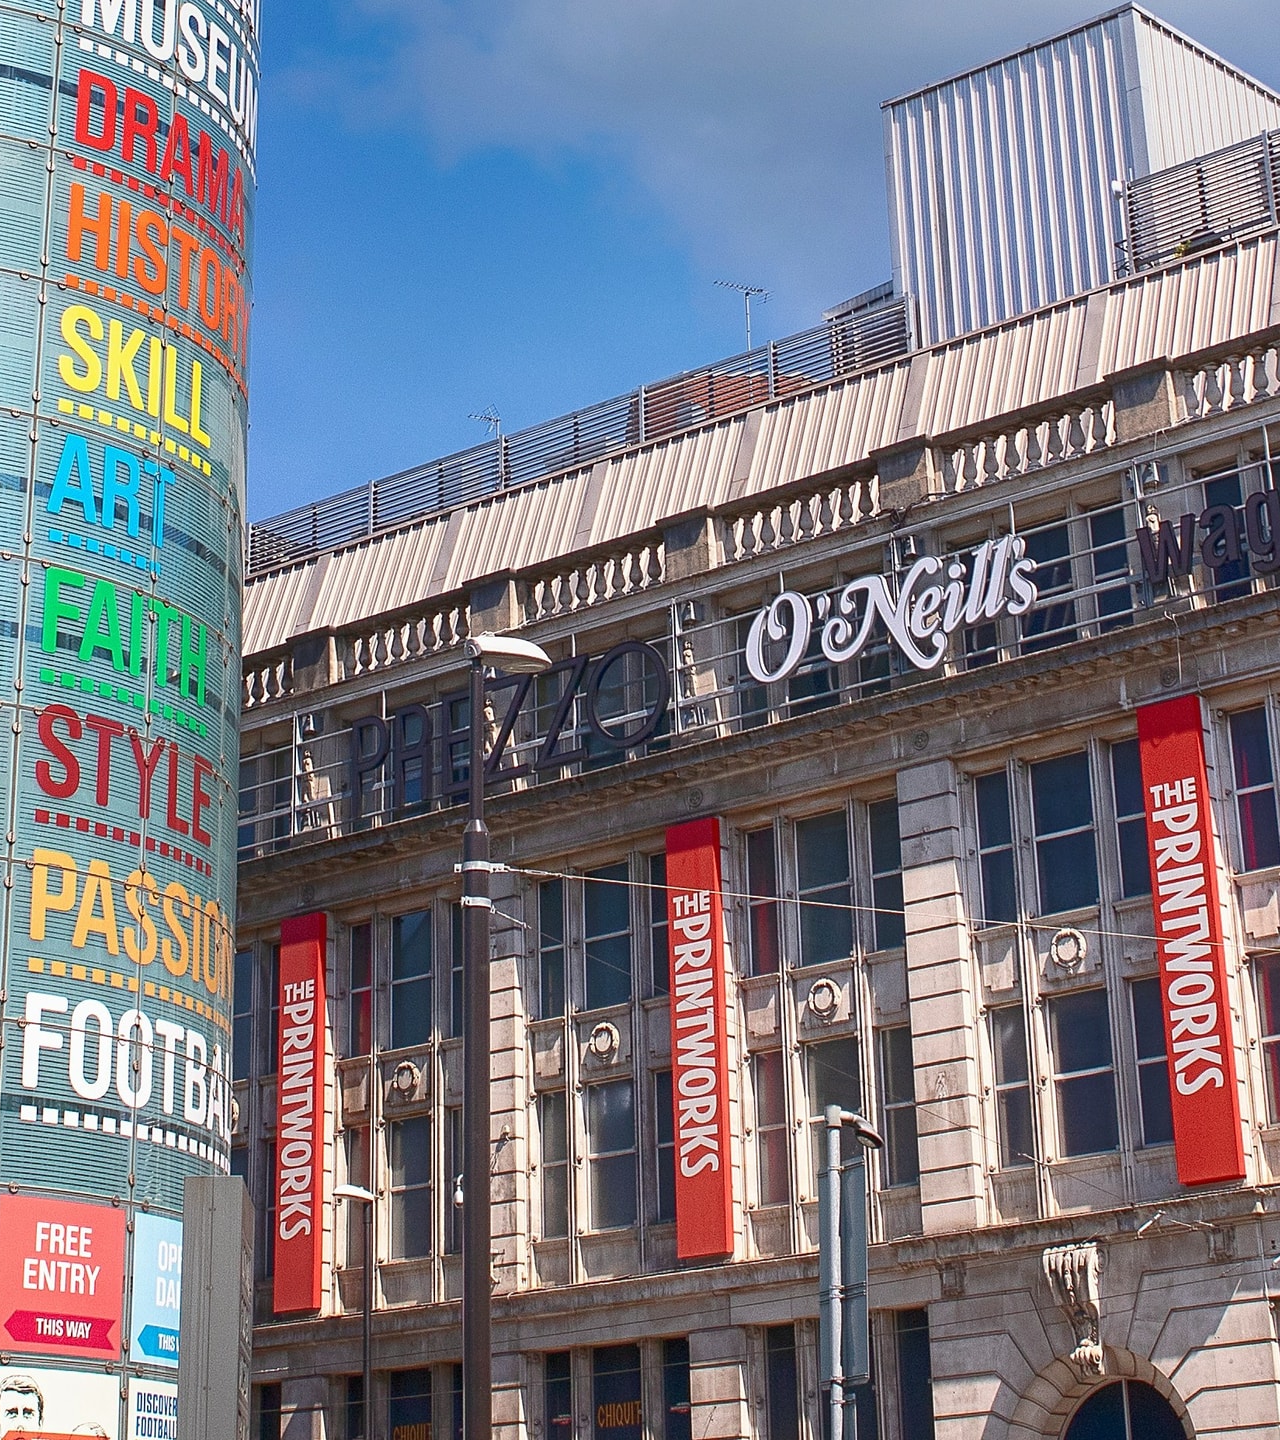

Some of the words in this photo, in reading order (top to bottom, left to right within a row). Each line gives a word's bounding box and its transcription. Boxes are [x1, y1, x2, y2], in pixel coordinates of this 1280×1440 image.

[74, 67, 244, 250] DRAMA
[67, 182, 250, 368] HISTORY
[59, 306, 212, 449] SKILL
[47, 433, 176, 548] ART
[42, 566, 208, 708] FAITH
[35, 703, 214, 848] STYLE
[350, 641, 669, 821] PREZZO
[1150, 777, 1198, 810] THE
[30, 848, 233, 1002] PASSION
[673, 890, 711, 918] THE
[1151, 801, 1224, 1095] PRINTWORKS
[284, 978, 315, 1003] THE
[673, 912, 719, 1179] PRINTWORKS
[279, 1003, 315, 1242] PRINTWORKS
[23, 1258, 100, 1296] ENTRY
[35, 1222, 92, 1258] FREE
[36, 1318, 63, 1337] THIS
[65, 1322, 91, 1340] WAY
[158, 1333, 176, 1352] THIS
